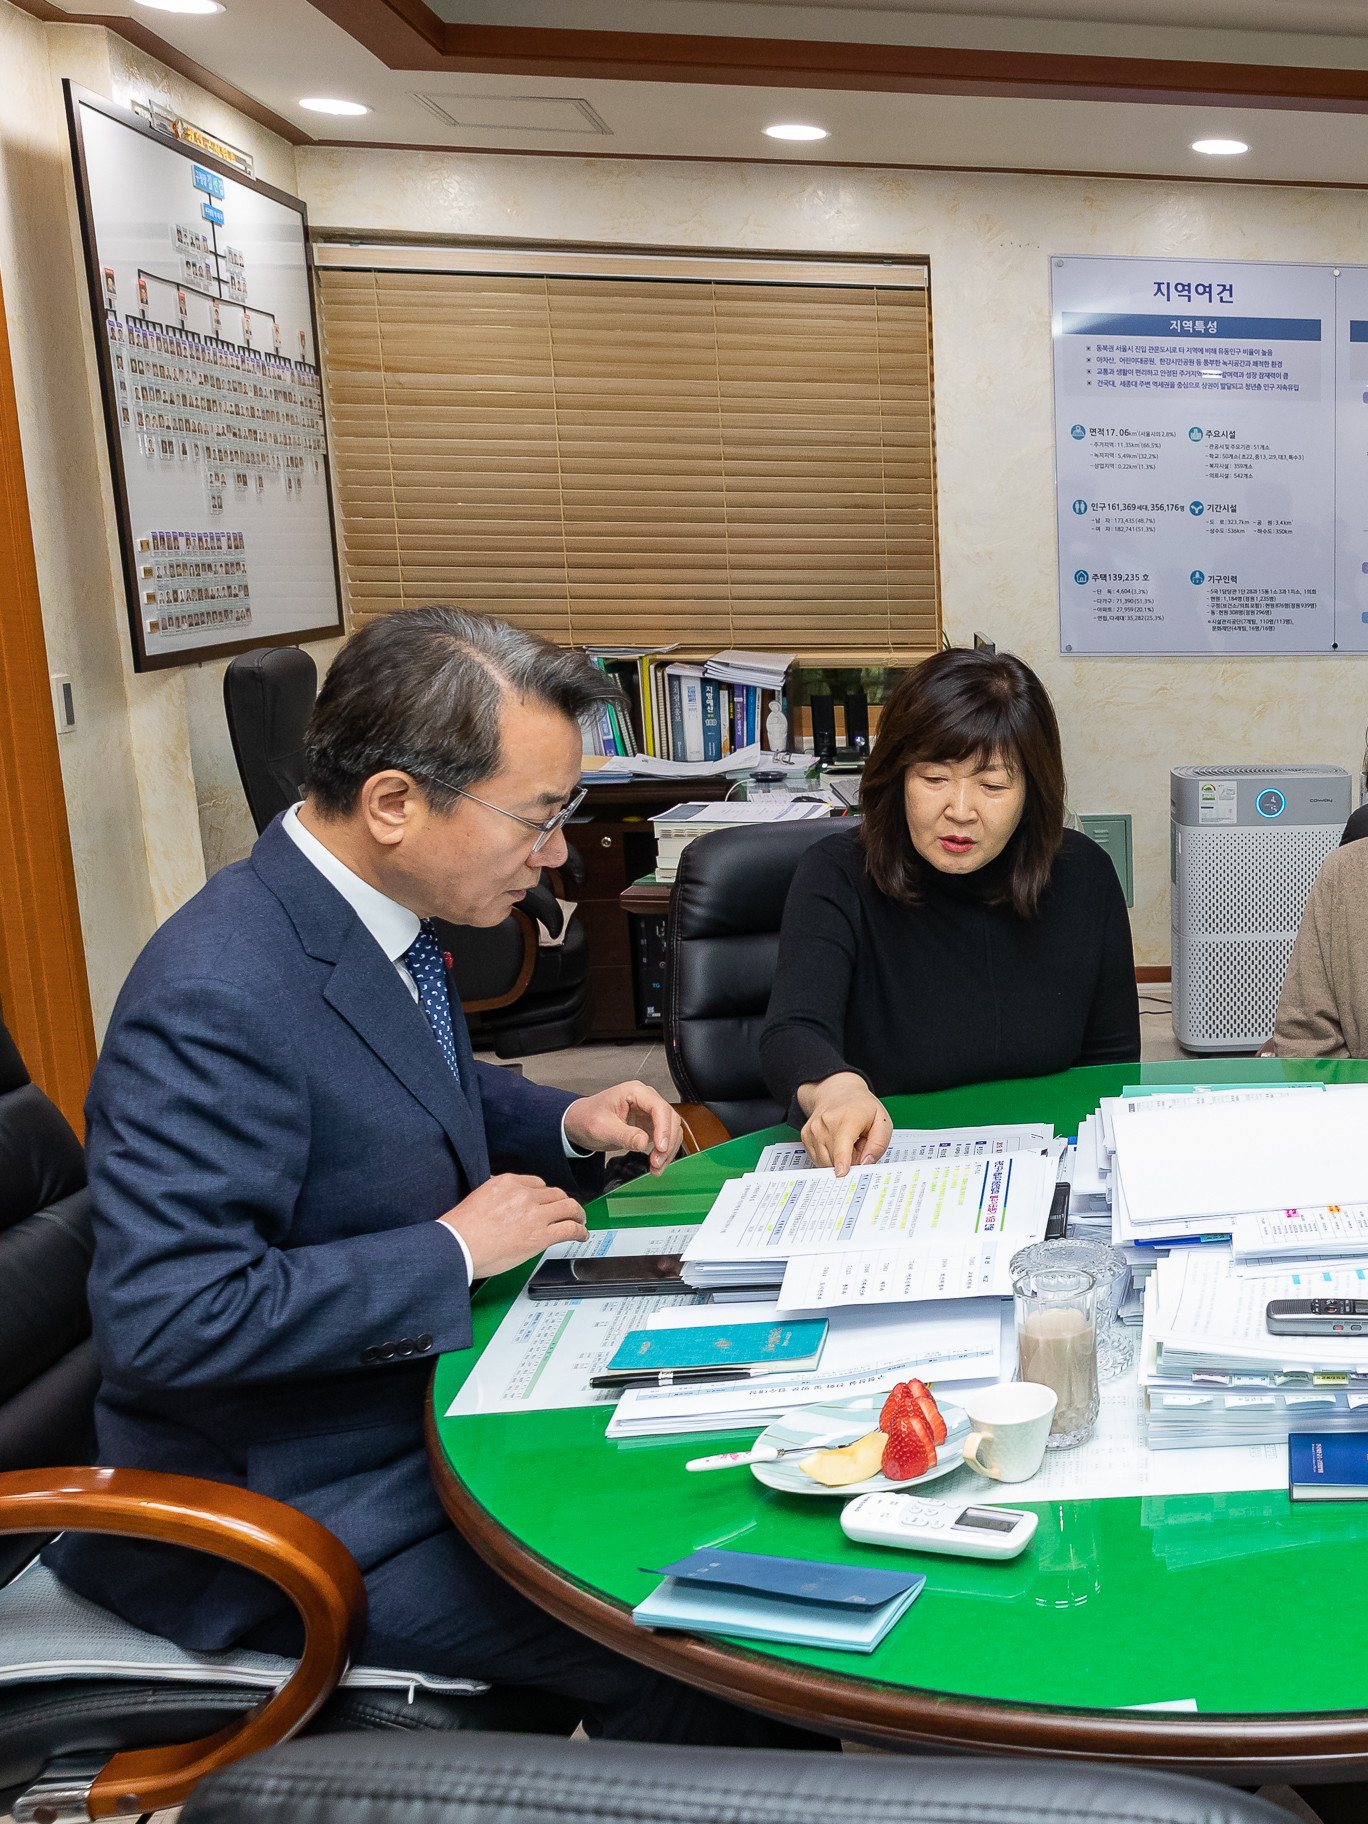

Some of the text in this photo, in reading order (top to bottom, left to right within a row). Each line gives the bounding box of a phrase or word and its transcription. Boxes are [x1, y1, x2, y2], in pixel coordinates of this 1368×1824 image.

[1153, 281, 1234, 304] 지역여건
[1169, 320, 1218, 334] 지역특성
[1116, 345, 1133, 353] 서울시
[1135, 345, 1146, 353] 진입
[1148, 346, 1177, 354] 관문도시로
[1160, 358, 1194, 366] 한강시민공원
[1096, 368, 1114, 376] 교통과
[1135, 369, 1158, 377] 편리하고
[1160, 369, 1177, 377] 안정된
[1177, 381, 1200, 389] 중심으로
[1220, 382, 1243, 390] 발달되고
[1205, 430, 1236, 439] 주요시설
[1207, 504, 1237, 513] 기간시설
[1142, 573, 1150, 581] 호
[1207, 575, 1238, 584] 기구인력
